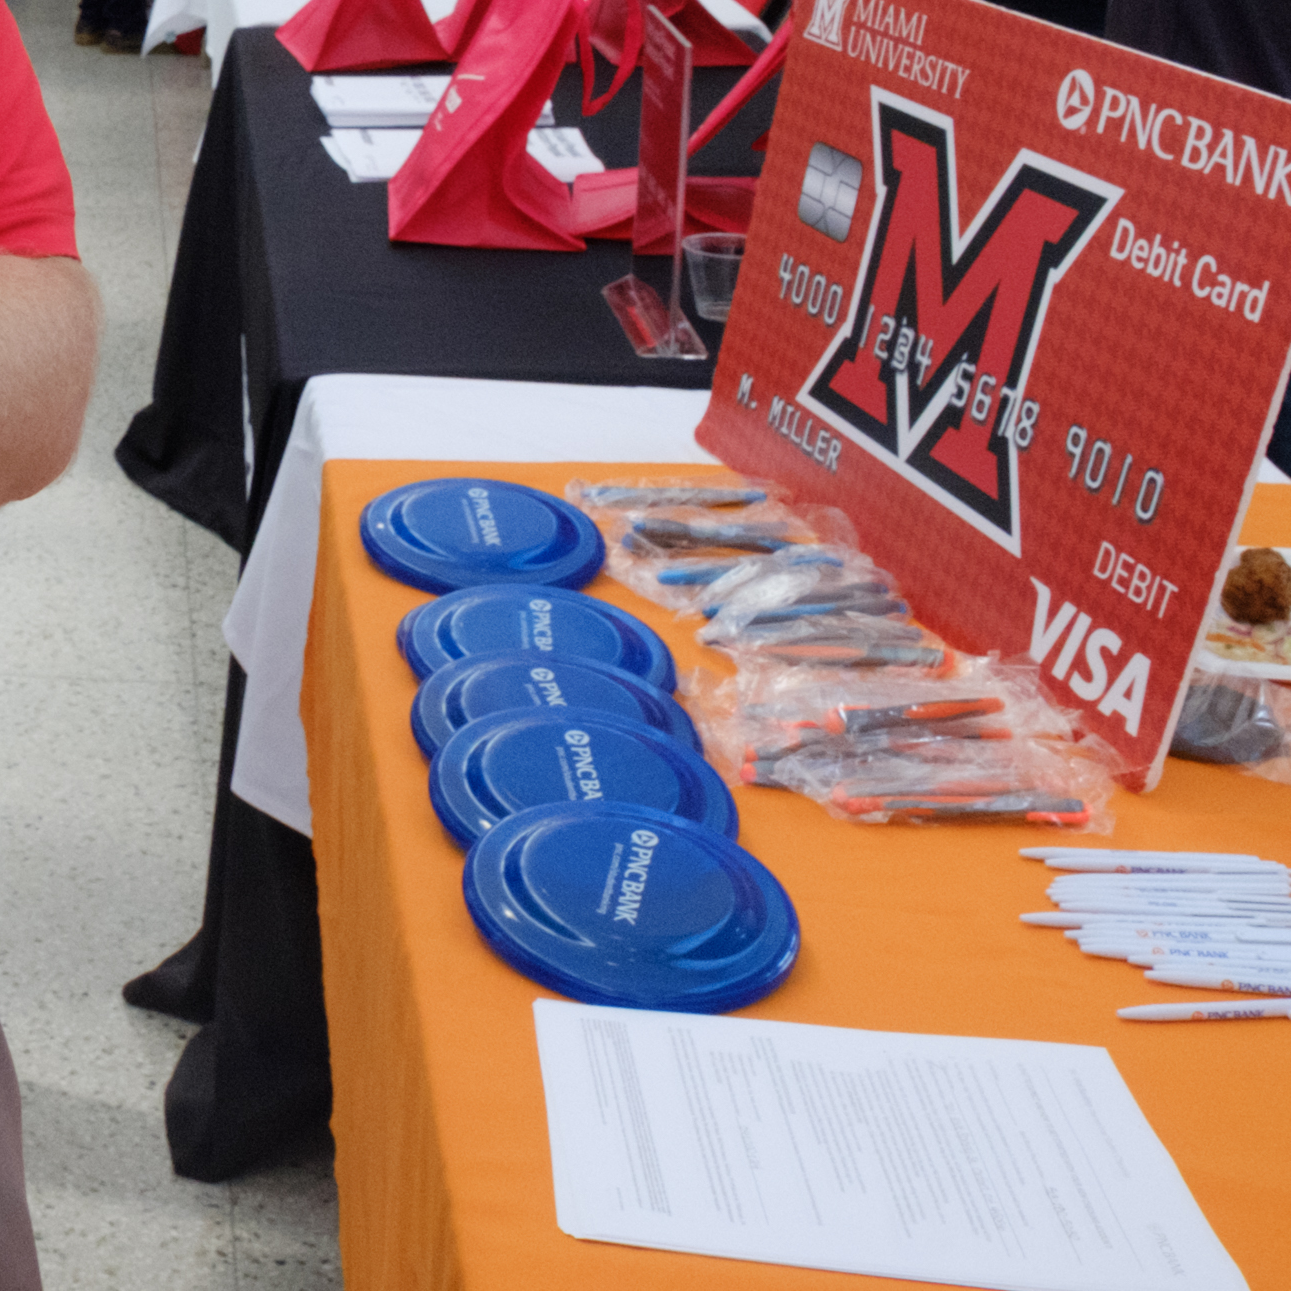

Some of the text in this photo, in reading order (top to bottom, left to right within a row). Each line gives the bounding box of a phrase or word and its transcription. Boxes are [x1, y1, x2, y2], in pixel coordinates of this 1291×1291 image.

[847, 25, 971, 100] UNIVERSITY
[1109, 217, 1270, 324] Debit Card
[737, 372, 843, 474] M. MILLER
[778, 252, 1165, 522] 4000 1234 5678 9010
[1093, 541, 1179, 619] DEBIT
[1029, 575, 1152, 738] VISA
